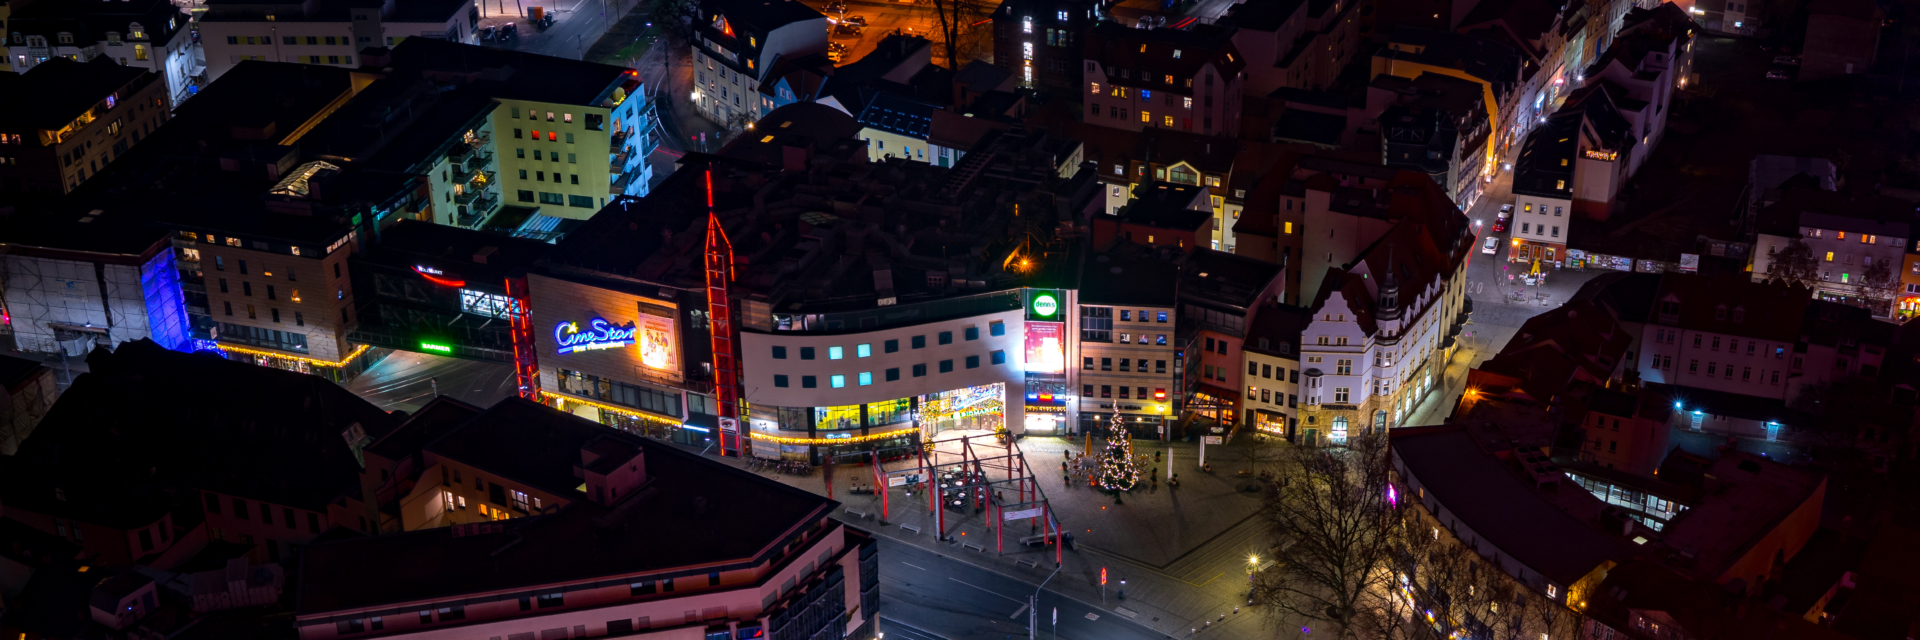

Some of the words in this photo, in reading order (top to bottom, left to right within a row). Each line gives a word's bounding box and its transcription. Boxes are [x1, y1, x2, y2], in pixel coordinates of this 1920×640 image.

[1467, 281, 1484, 294] 20
[554, 318, 637, 346] CineStar
[421, 343, 450, 352] BARMER
